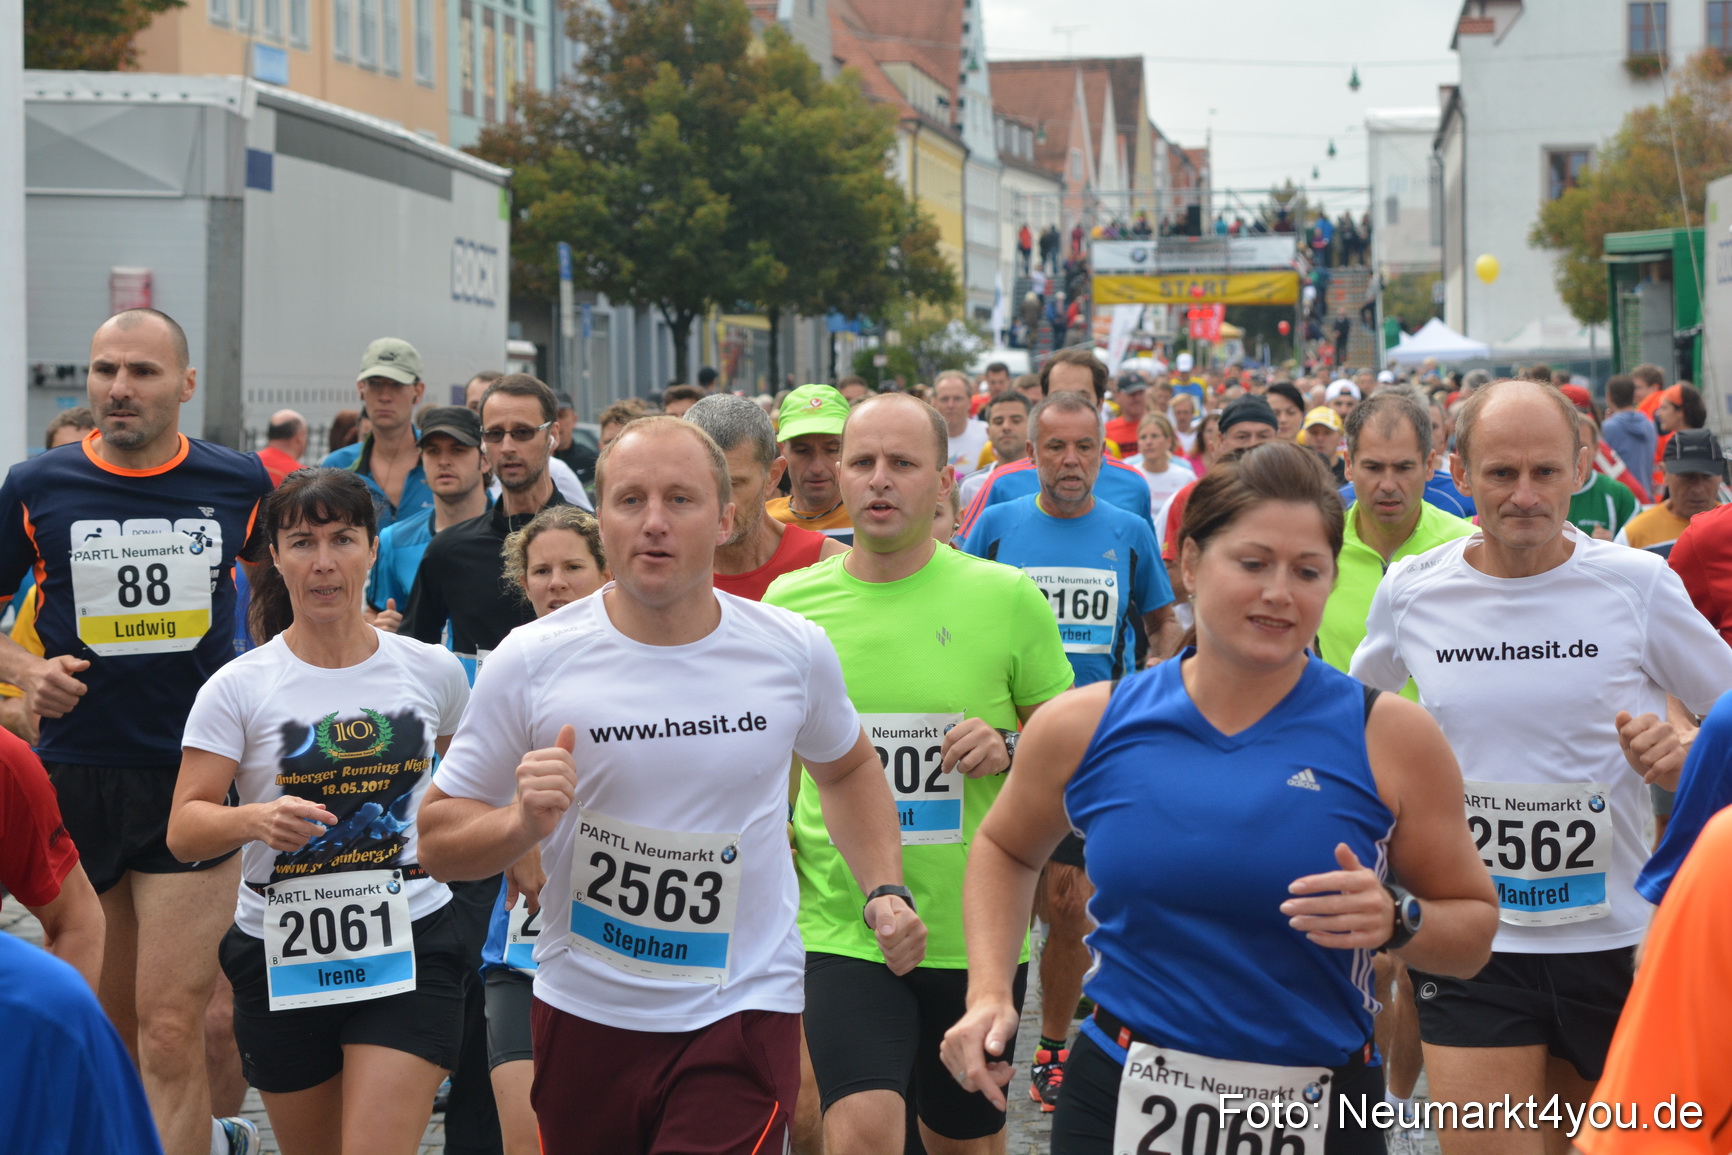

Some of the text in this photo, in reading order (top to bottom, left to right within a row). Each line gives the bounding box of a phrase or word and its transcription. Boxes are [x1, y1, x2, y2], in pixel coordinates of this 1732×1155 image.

[74, 545, 184, 561] PARTL Neumarkt
[117, 563, 171, 608] 88
[1058, 576, 1101, 585] Neumarkt
[114, 619, 176, 638] Ludwig
[1436, 639, 1599, 664] www.hasit.de
[589, 711, 768, 743] www.hasit.de
[872, 727, 938, 738] Neumarkt
[275, 770, 337, 786] Amberger
[342, 761, 401, 778] Running
[1286, 779, 1321, 791] adidas
[321, 779, 391, 795] 18.05.2013
[1464, 793, 1581, 812] ARTL Neumarkt
[579, 822, 714, 862] PARTL Neumarkt
[1467, 815, 1596, 872] 2562
[268, 891, 311, 906] PARTL
[315, 884, 382, 900] Neumarkt
[587, 851, 723, 925] 2563
[279, 901, 393, 958] 2061
[602, 922, 688, 960] Stephan
[318, 968, 366, 987] Irene
[1128, 1062, 1295, 1101] PARTL Neumarkt
